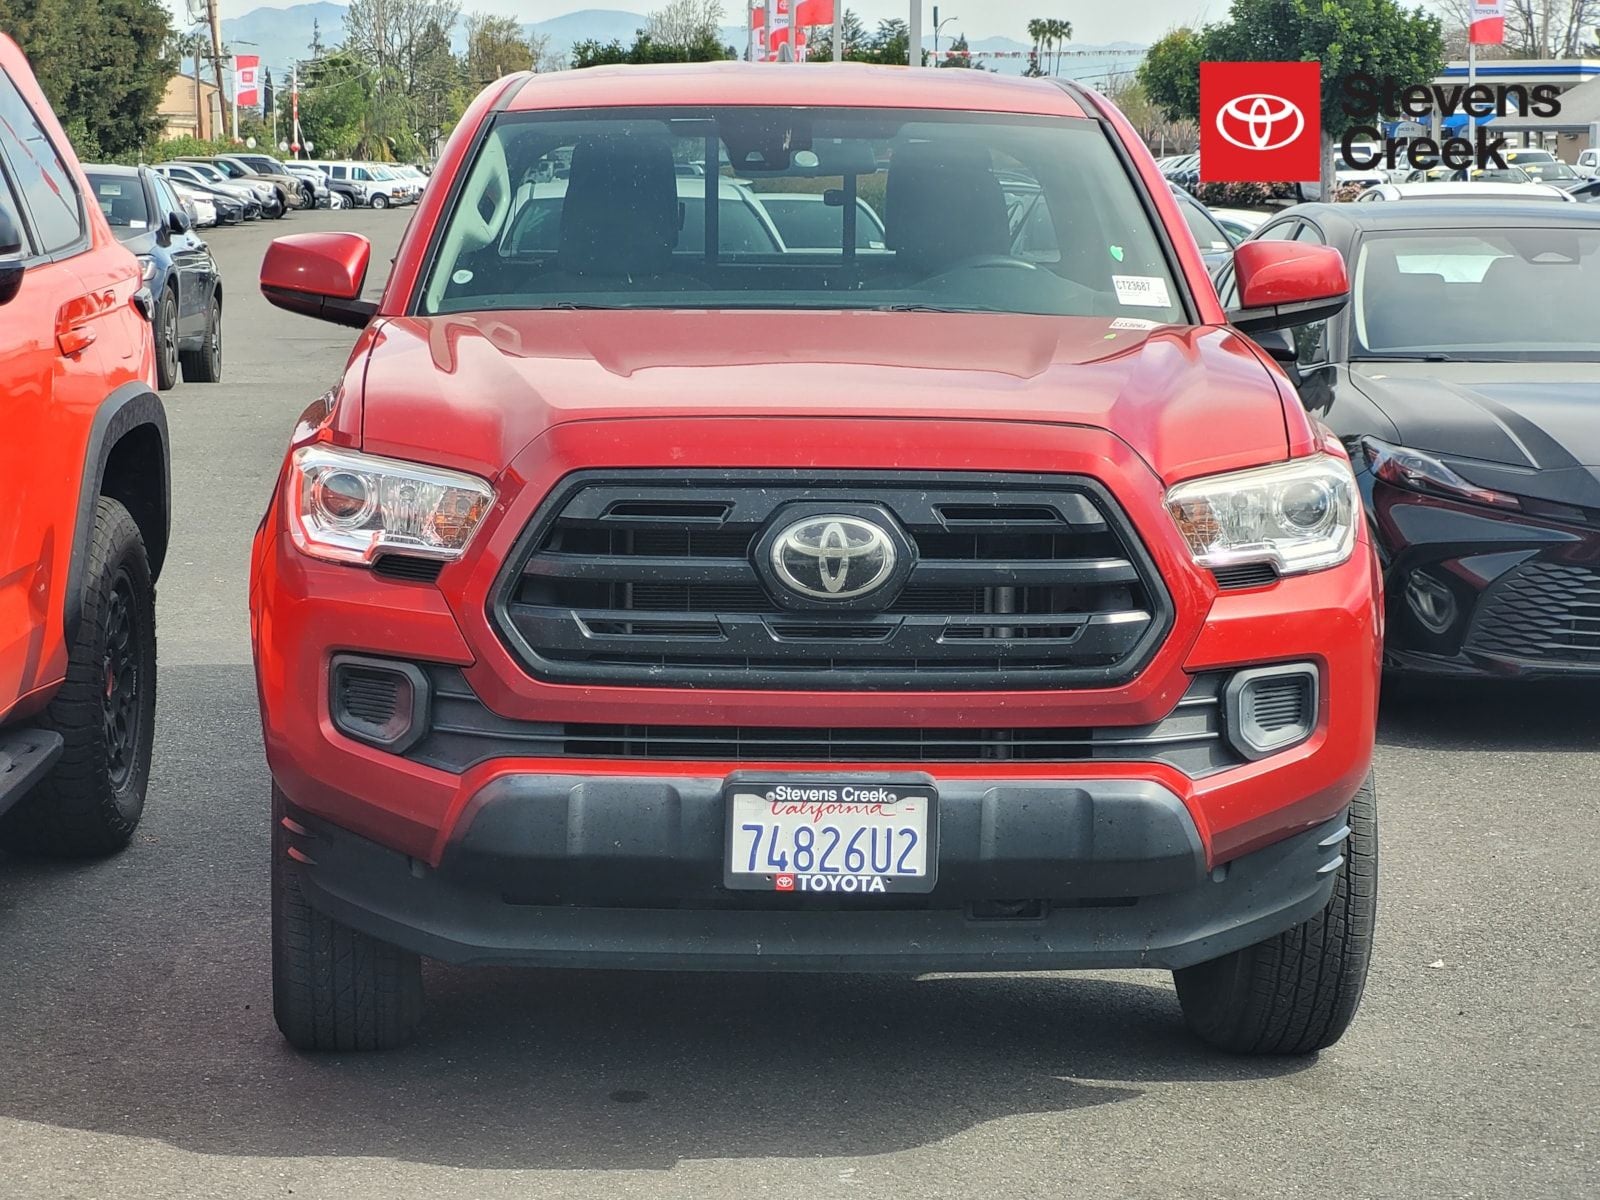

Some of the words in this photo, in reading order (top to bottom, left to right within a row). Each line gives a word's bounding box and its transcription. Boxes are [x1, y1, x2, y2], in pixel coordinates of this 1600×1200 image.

[775, 785, 837, 802] Stevens
[841, 787, 888, 803] Creek
[771, 801, 896, 823] California
[741, 824, 919, 874] 74826U2
[798, 874, 886, 892] TOYOTA
